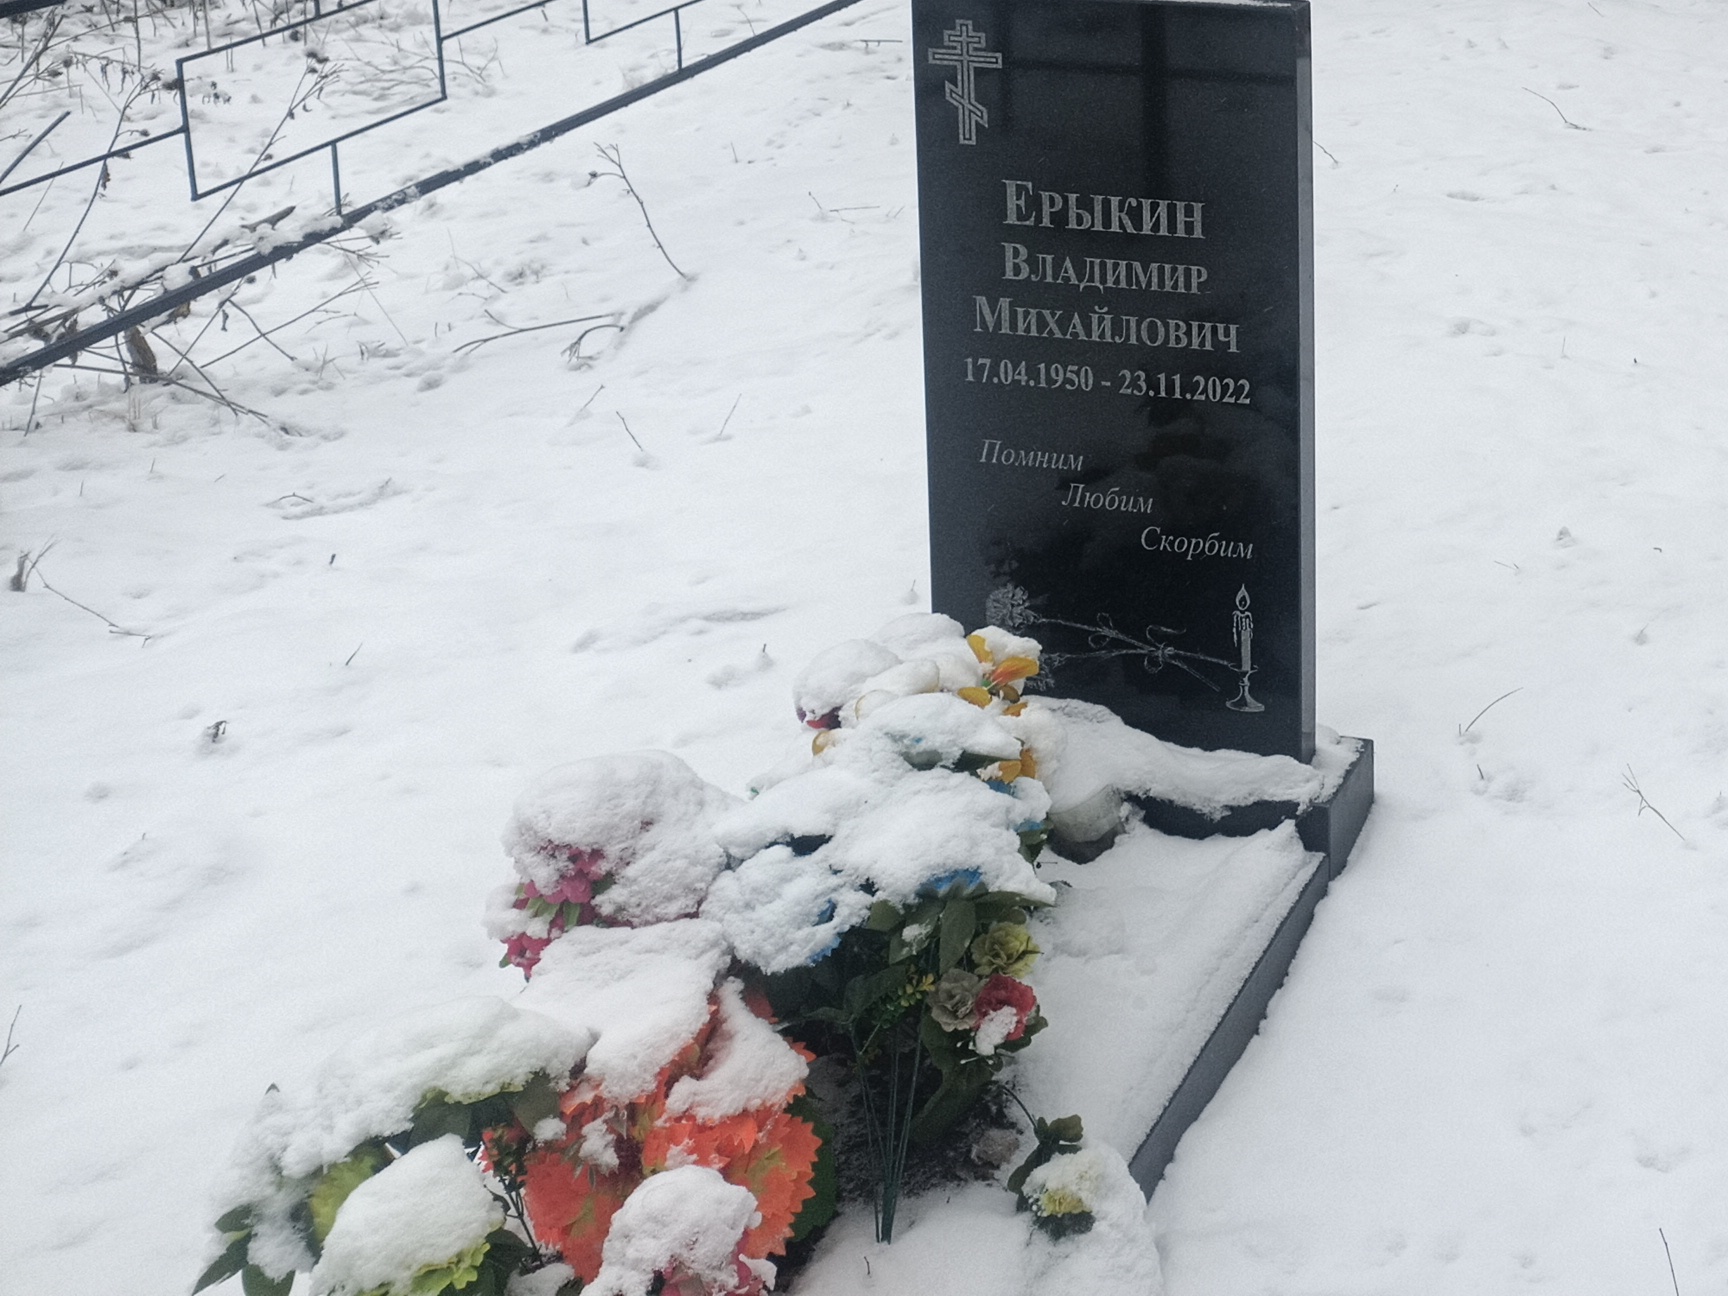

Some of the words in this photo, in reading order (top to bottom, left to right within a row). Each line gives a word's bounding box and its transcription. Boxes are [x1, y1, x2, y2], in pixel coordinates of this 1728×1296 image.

[964, 357, 1094, 392] 17.04.1950
[1118, 369, 1252, 405] 23.11.2022
[979, 439, 1084, 472] Помним
[1061, 483, 1154, 514] Любим
[1140, 526, 1254, 561] Скорбим
